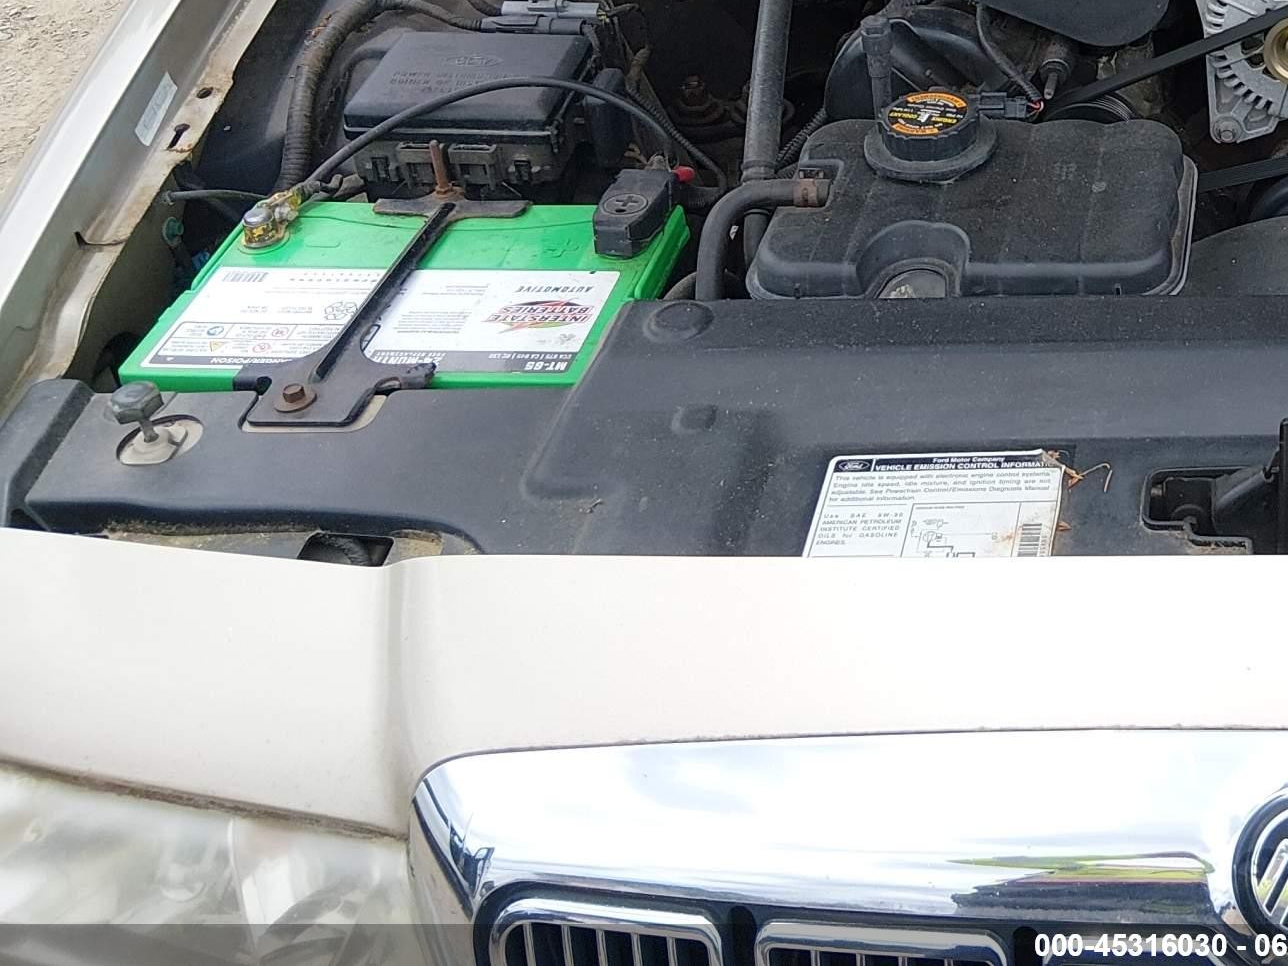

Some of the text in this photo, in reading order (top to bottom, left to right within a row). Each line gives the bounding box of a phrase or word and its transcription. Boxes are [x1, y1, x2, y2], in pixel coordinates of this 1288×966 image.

[515, 285, 594, 293] AUTOMOTIVE
[502, 306, 590, 314] BATTERIES
[489, 314, 589, 322] INTERSTATE
[524, 361, 568, 371] MT-65
[972, 456, 1005, 464] Company
[913, 463, 955, 471] EMISSION
[957, 462, 999, 470] CONTROL
